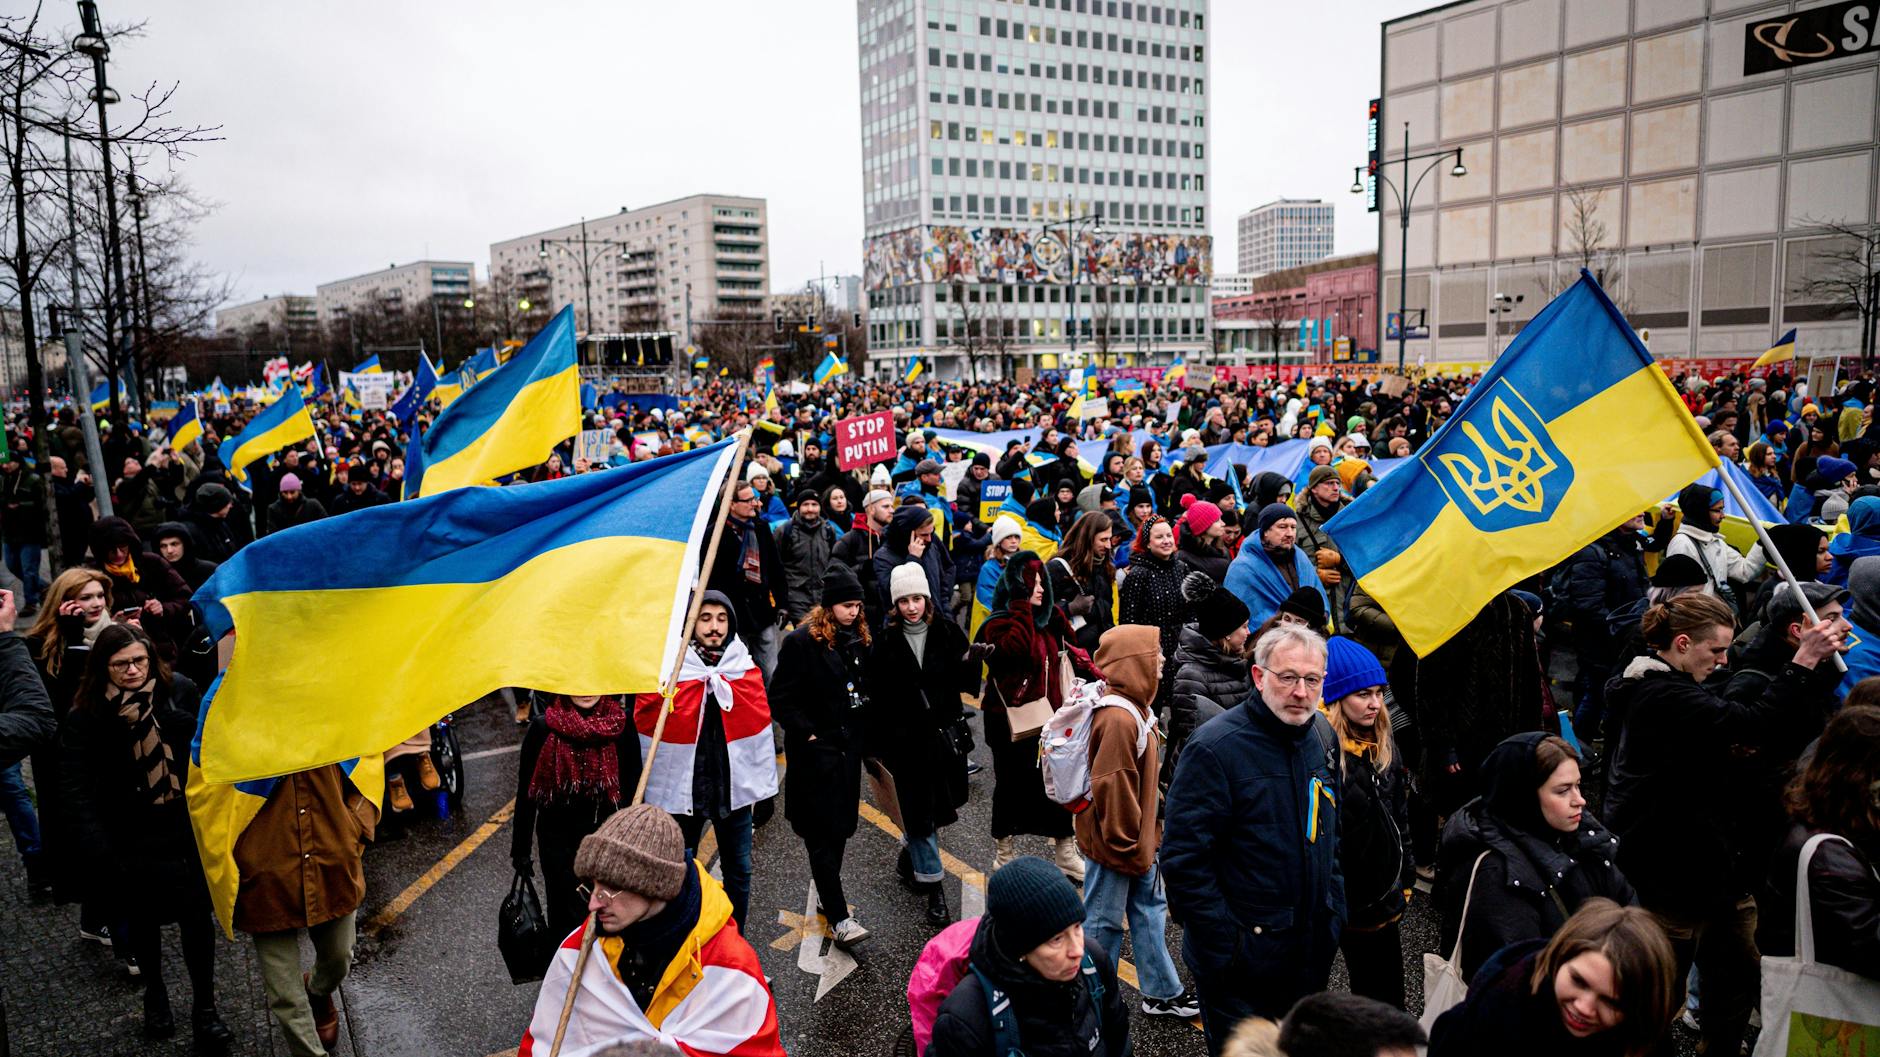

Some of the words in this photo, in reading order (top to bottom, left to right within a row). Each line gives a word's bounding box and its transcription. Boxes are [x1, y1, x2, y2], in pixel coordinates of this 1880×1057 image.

[848, 416, 885, 439] STOP
[845, 436, 889, 463] PUTIN
[986, 485, 1005, 497] STOP
